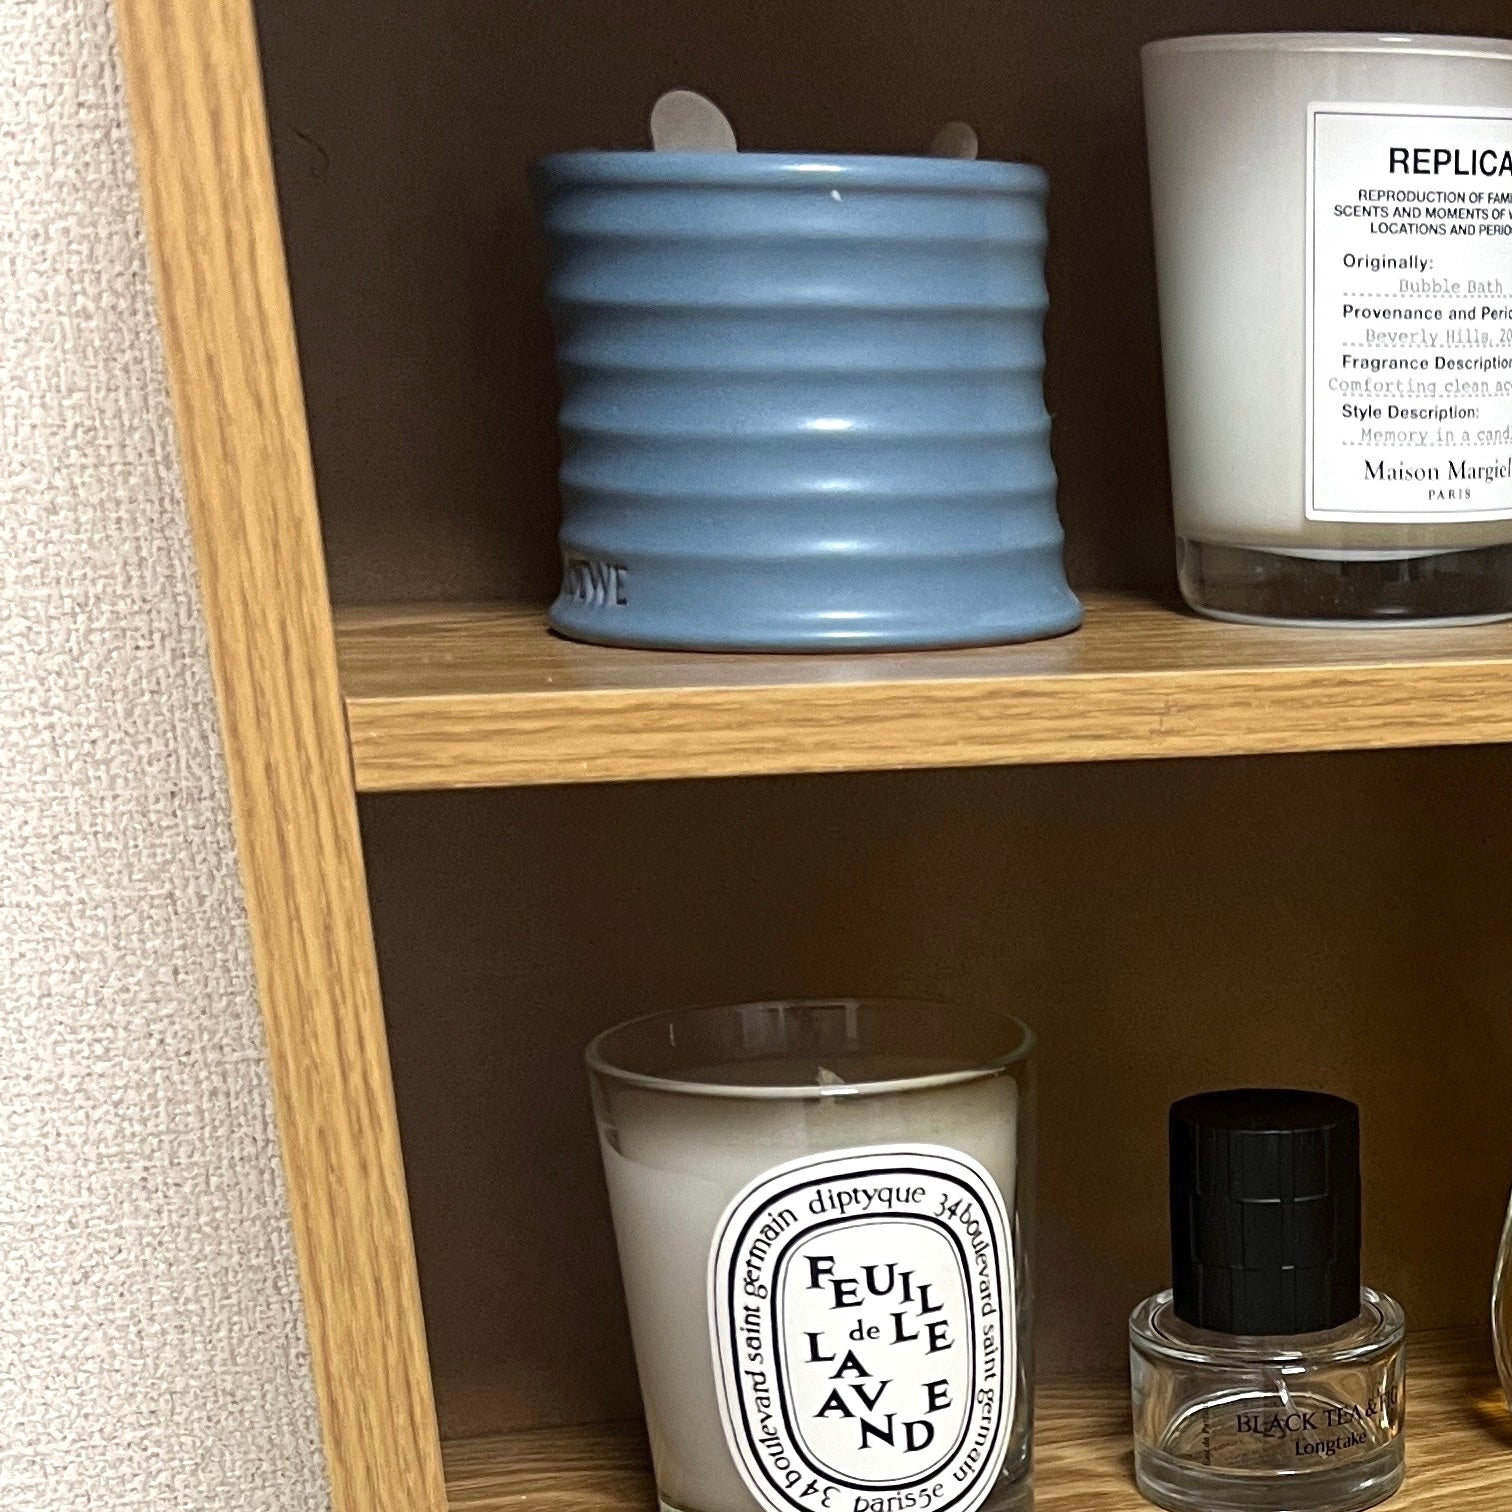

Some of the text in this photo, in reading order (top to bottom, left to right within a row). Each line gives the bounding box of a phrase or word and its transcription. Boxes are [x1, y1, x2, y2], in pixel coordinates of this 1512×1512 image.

[1358, 189, 1466, 203] REPRODUCTION
[1469, 192, 1485, 203] OF
[1334, 205, 1389, 218] SCENTS
[1392, 207, 1421, 219] AND
[1425, 207, 1488, 220] MOMENTS
[1491, 208, 1506, 220] OF
[1370, 222, 1446, 236] LOCATIONS
[1450, 224, 1476, 236] AND
[1343, 253, 1434, 272] Originally:
[1399, 278, 1503, 294] Bubble Bath
[1343, 304, 1443, 320] Provenance
[1448, 305, 1477, 320] and
[1365, 328, 1438, 347] Beverly
[1446, 328, 1493, 346] Hills,
[1342, 355, 1429, 372] Fragrance
[1328, 377, 1437, 397] Comforting
[1444, 378, 1489, 393] clean
[1342, 404, 1480, 421] Style Description:
[1360, 427, 1428, 445] Memory
[1437, 427, 1454, 442] in
[1461, 431, 1471, 442] a
[1364, 459, 1439, 481] Maison
[1428, 489, 1471, 500] PARIS
[808, 1185, 926, 1215] diptyque
[743, 1208, 799, 1300] germain
[739, 1305, 764, 1365] saint
[849, 1319, 881, 1342] de
[982, 1324, 998, 1382] saint
[1236, 1411, 1317, 1434] BLACK
[1324, 1405, 1362, 1428] TEA
[952, 1388, 995, 1482] germain
[1295, 1431, 1367, 1456] Longtake
